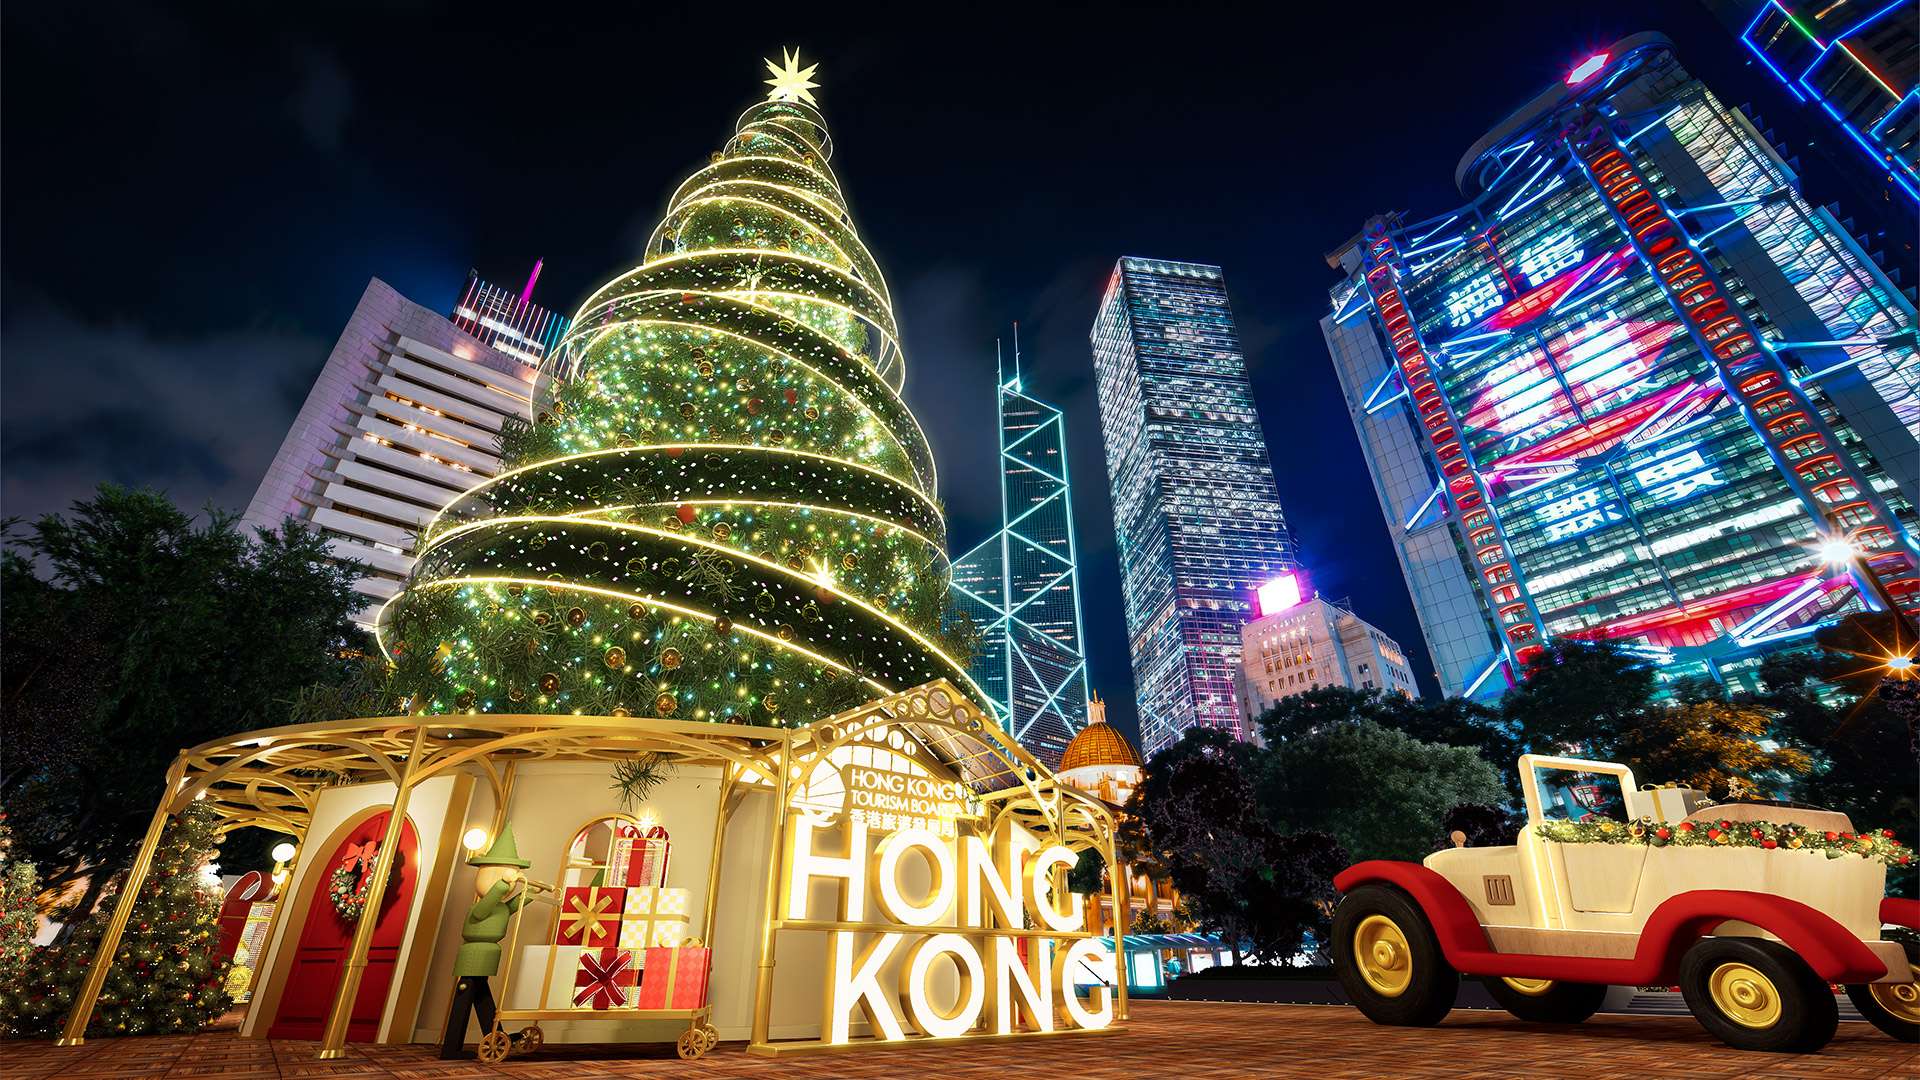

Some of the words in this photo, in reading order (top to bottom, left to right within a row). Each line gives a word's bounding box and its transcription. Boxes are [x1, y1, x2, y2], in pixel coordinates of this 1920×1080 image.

[850, 789, 909, 812] TOURISM
[851, 768, 905, 793] HONG
[907, 778, 955, 801] KONG
[788, 814, 1085, 932] HONG
[831, 932, 1114, 1045] KONG
